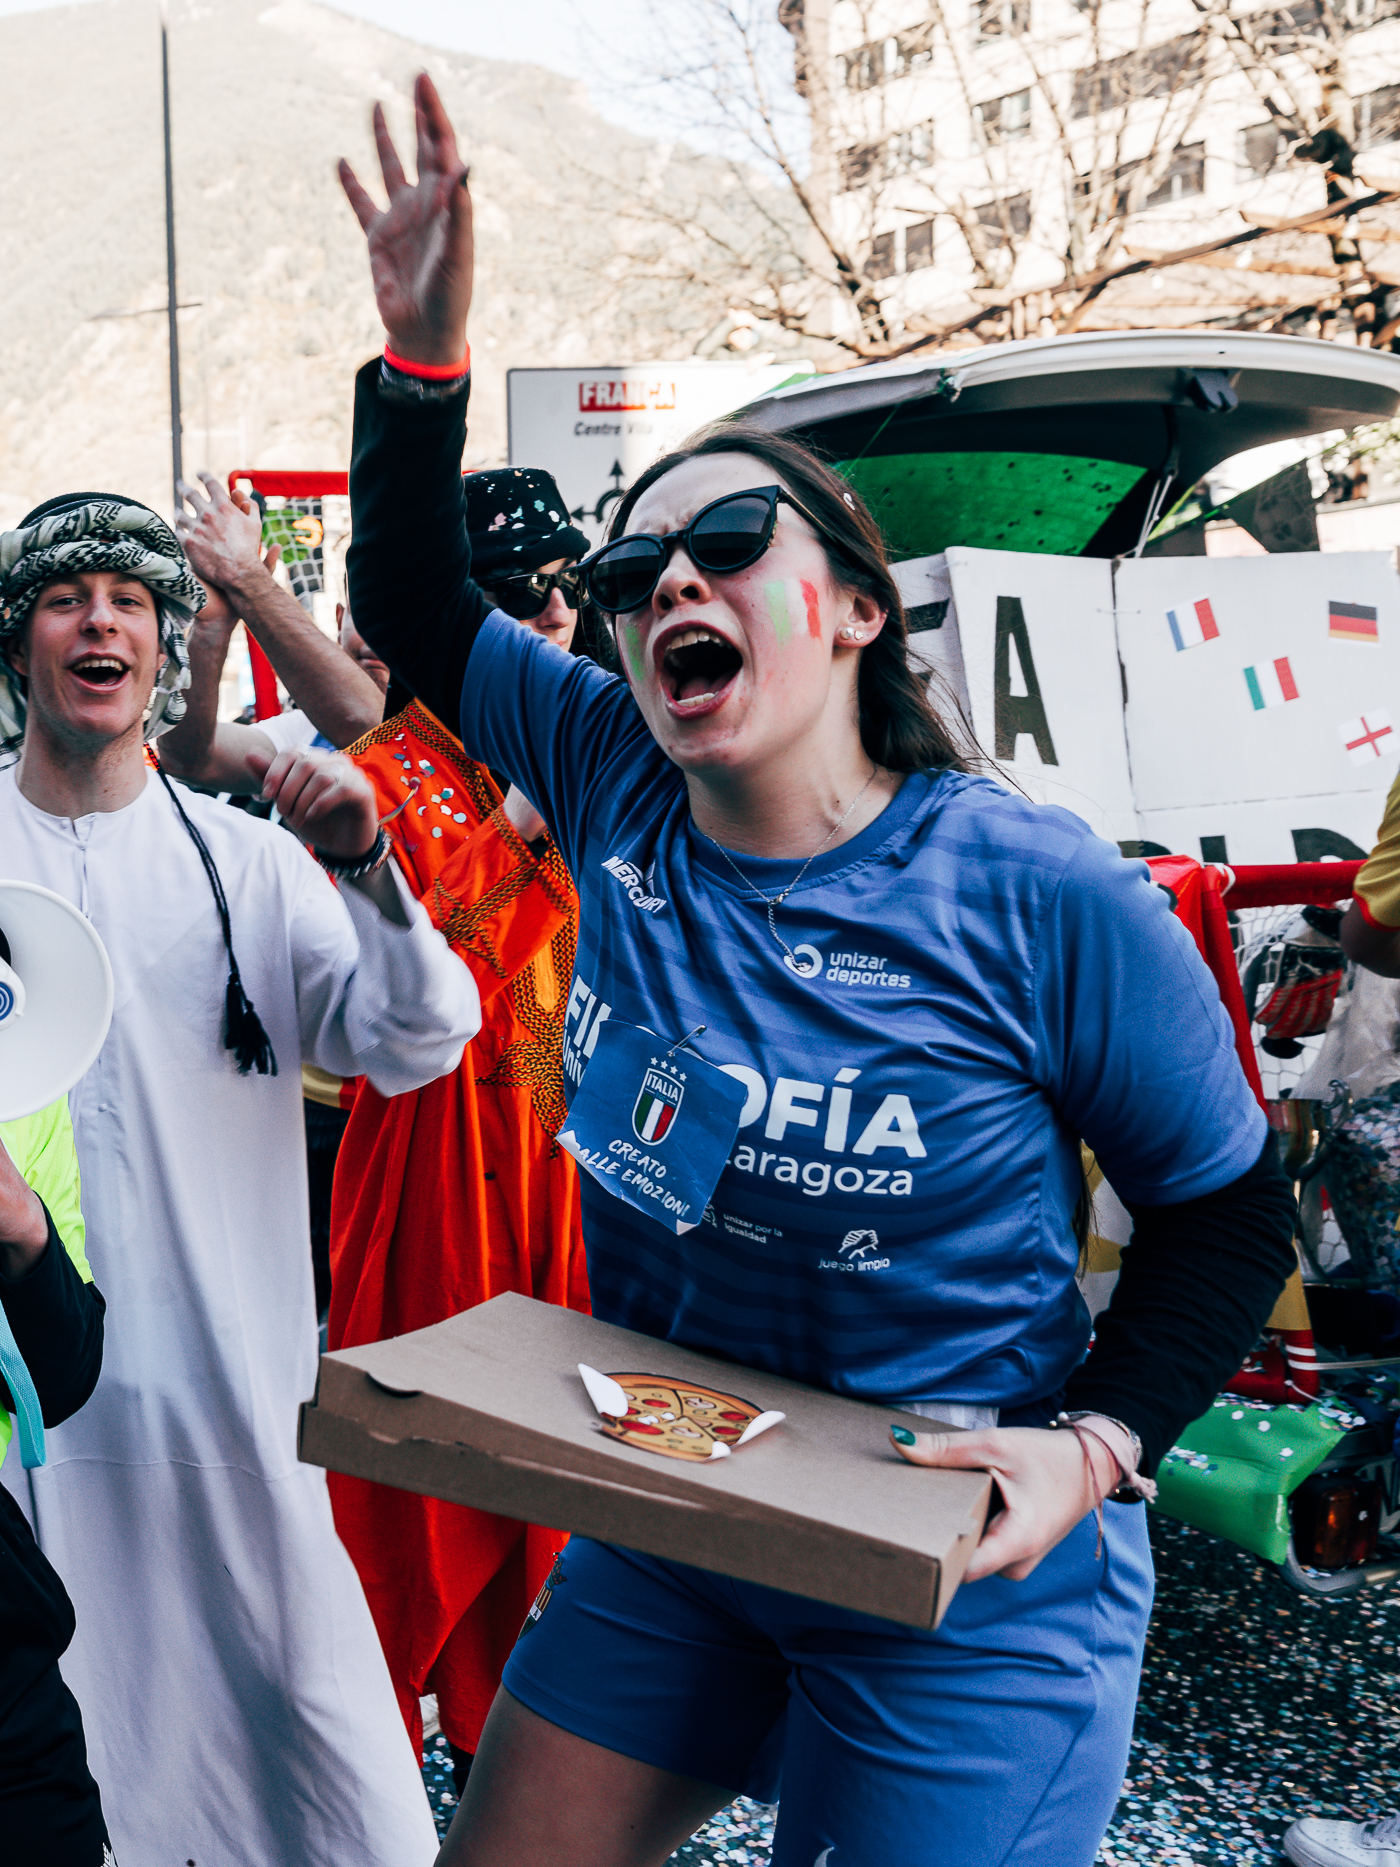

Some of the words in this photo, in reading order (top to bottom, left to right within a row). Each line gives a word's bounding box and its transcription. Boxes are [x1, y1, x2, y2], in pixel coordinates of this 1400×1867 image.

[574, 421, 621, 436] Centre
[601, 855, 667, 914] MERCURY
[829, 951, 887, 970] unizar
[825, 966, 911, 988] deportes
[646, 1073, 678, 1102] ITALIA
[576, 1143, 621, 1175] ALLE
[608, 1139, 667, 1179] CREATO
[726, 1145, 914, 1196] aragoza
[755, 1225, 772, 1235] por
[817, 1259, 854, 1271] juego
[857, 1257, 890, 1271] limpio
